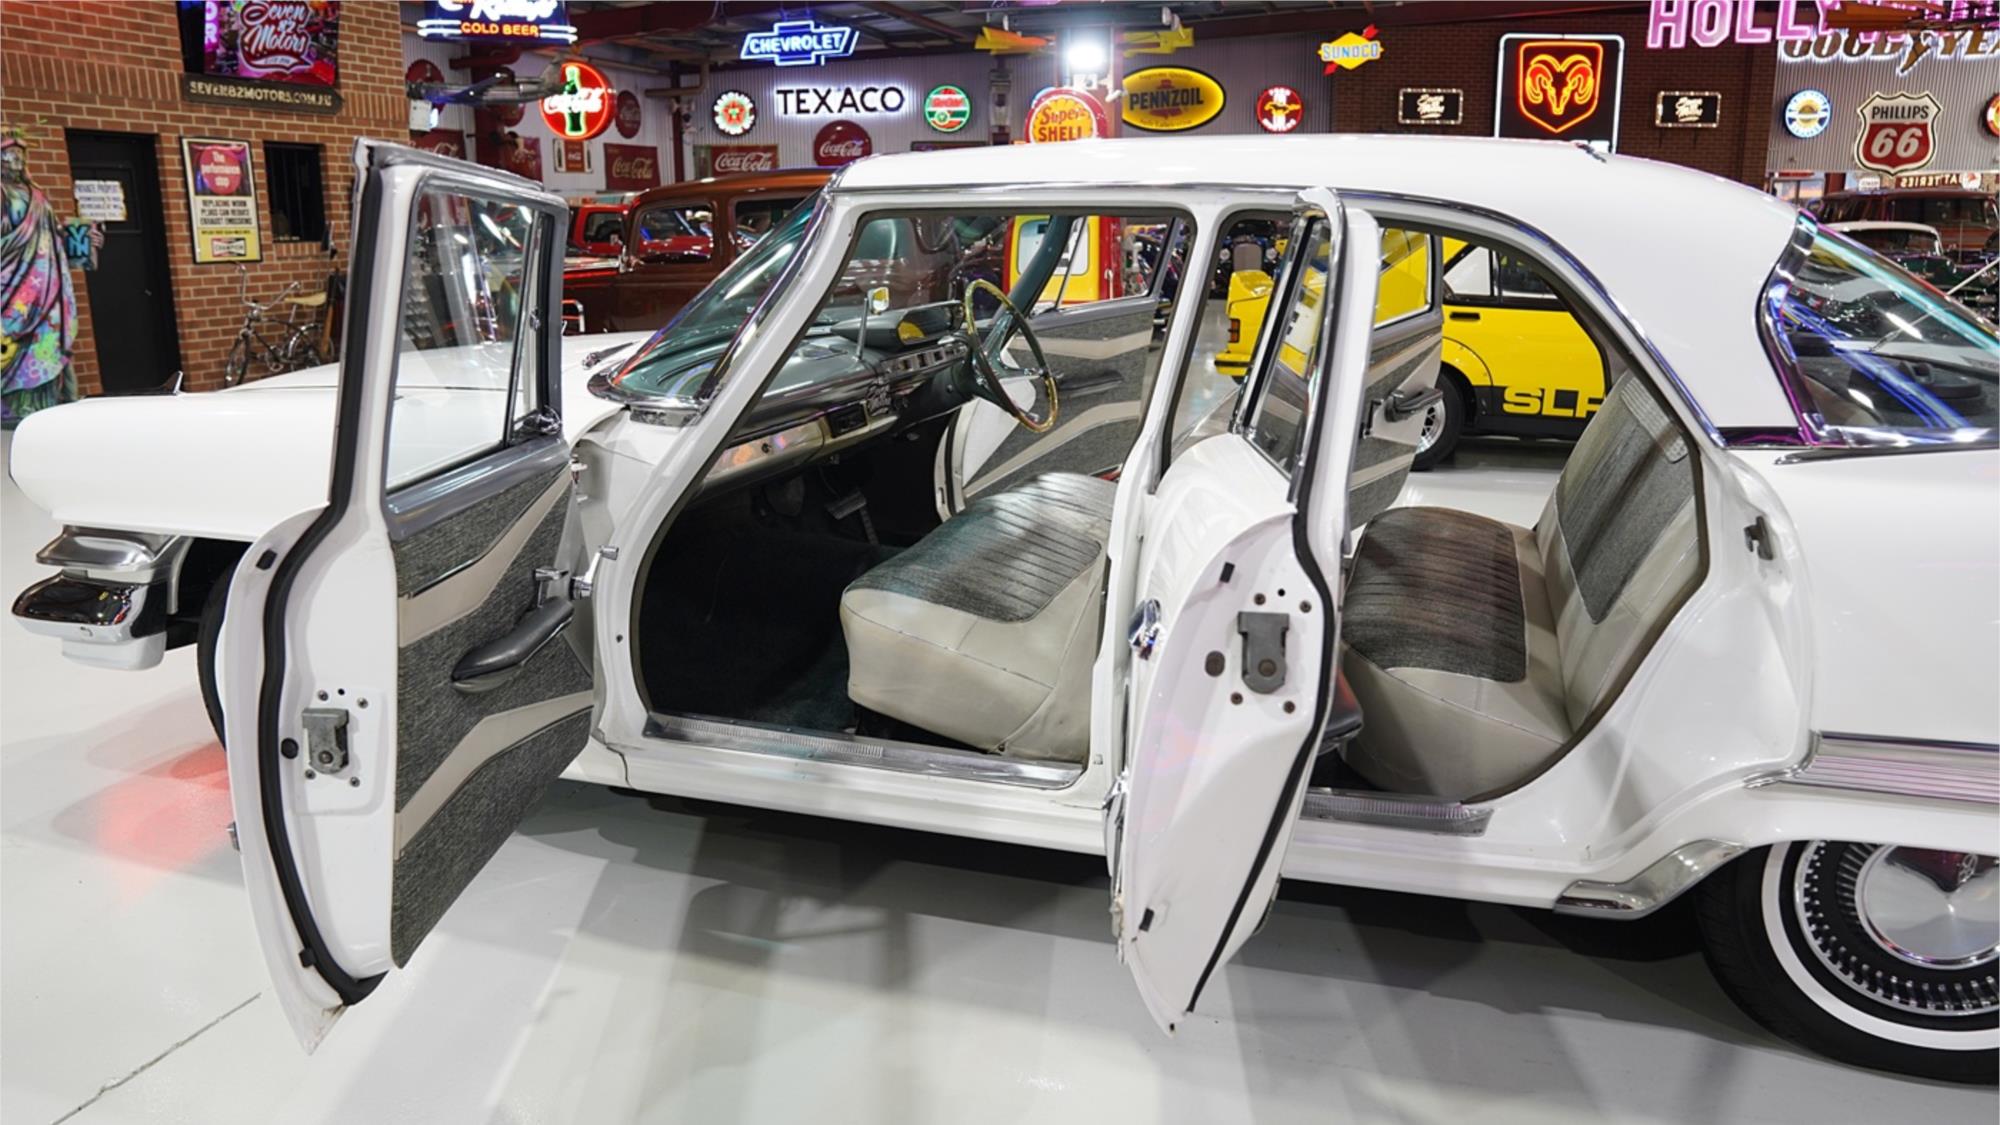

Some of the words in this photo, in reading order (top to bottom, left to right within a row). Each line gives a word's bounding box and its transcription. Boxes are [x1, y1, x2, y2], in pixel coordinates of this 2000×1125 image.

[243, 2, 305, 25] Seven
[244, 24, 306, 54] Motors
[461, 22, 499, 34] COLD
[503, 24, 539, 37] BEER
[750, 33, 842, 53] CHEVROLET
[1322, 43, 1381, 60] SUNOCO
[776, 86, 905, 115] TEXACO
[1129, 87, 1204, 111] PENNZOIL
[1040, 105, 1086, 126] Super
[1871, 105, 1930, 120] PHILLIPS
[1870, 127, 1923, 159] 66
